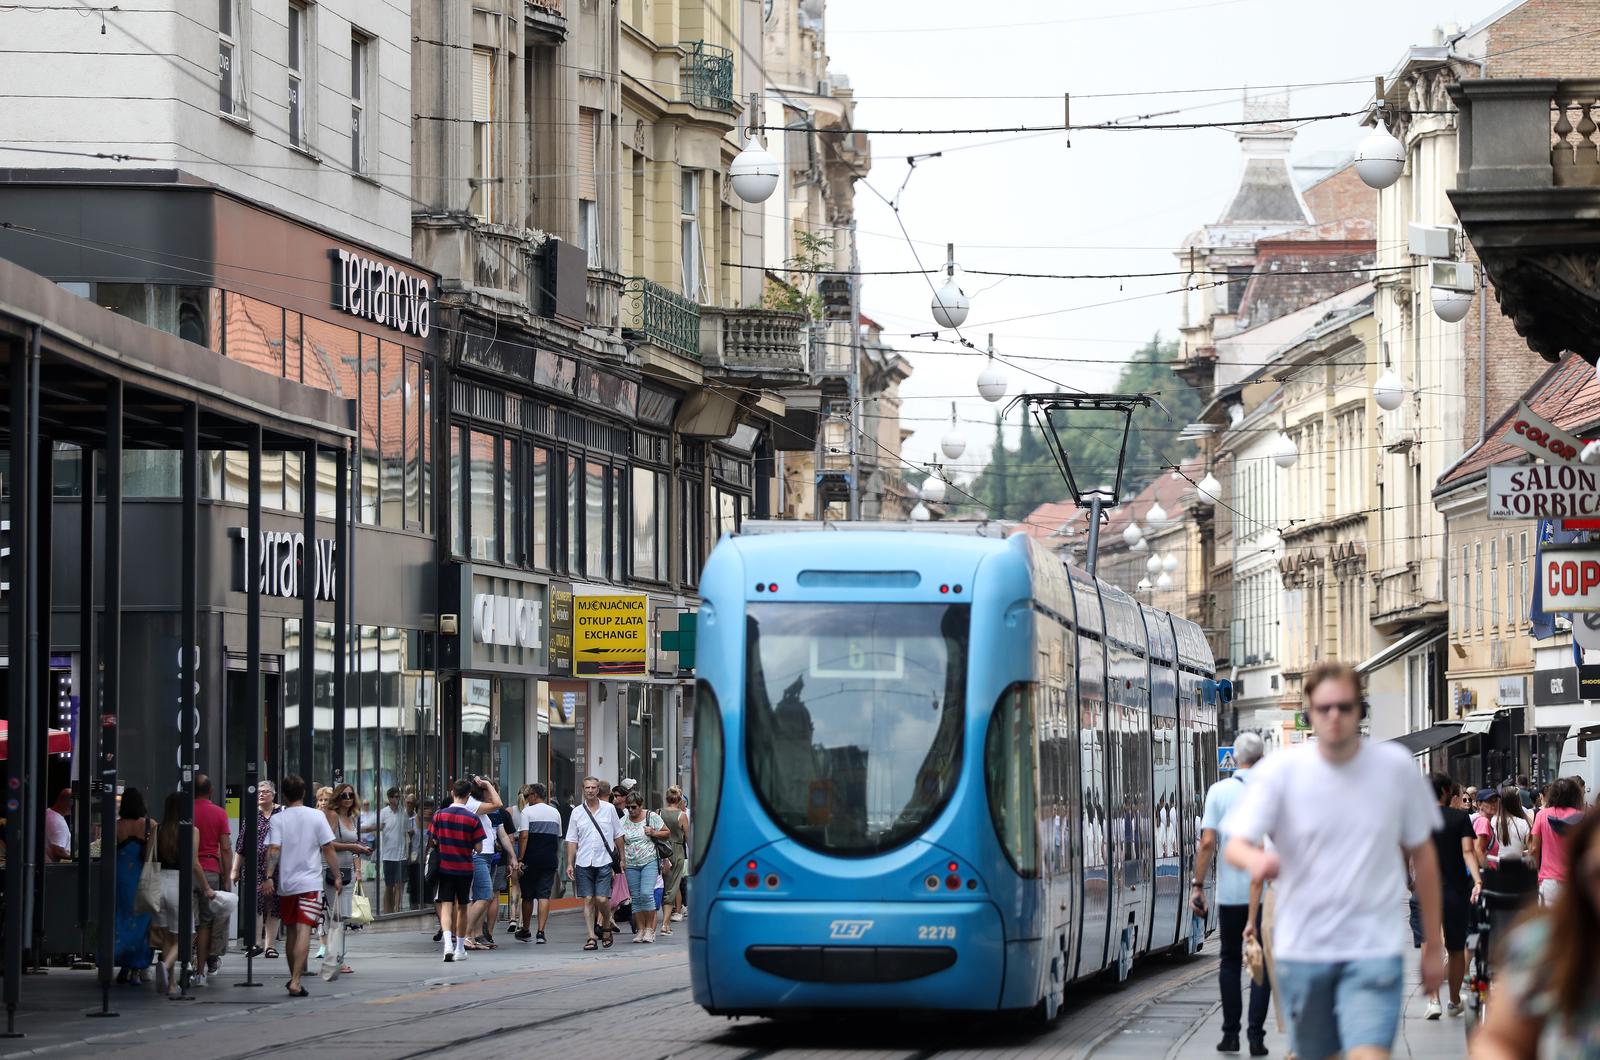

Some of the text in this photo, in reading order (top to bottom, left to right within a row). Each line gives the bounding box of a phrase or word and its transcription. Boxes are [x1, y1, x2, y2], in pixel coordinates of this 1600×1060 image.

[338, 248, 430, 339] Terranova
[1513, 420, 1577, 461] COLOR
[1510, 464, 1597, 493] SALON
[1548, 560, 1600, 597] COP
[579, 616, 644, 625] OTKUP ZLATA
[584, 630, 638, 640] EXCHANGE
[918, 926, 956, 940] 2279
